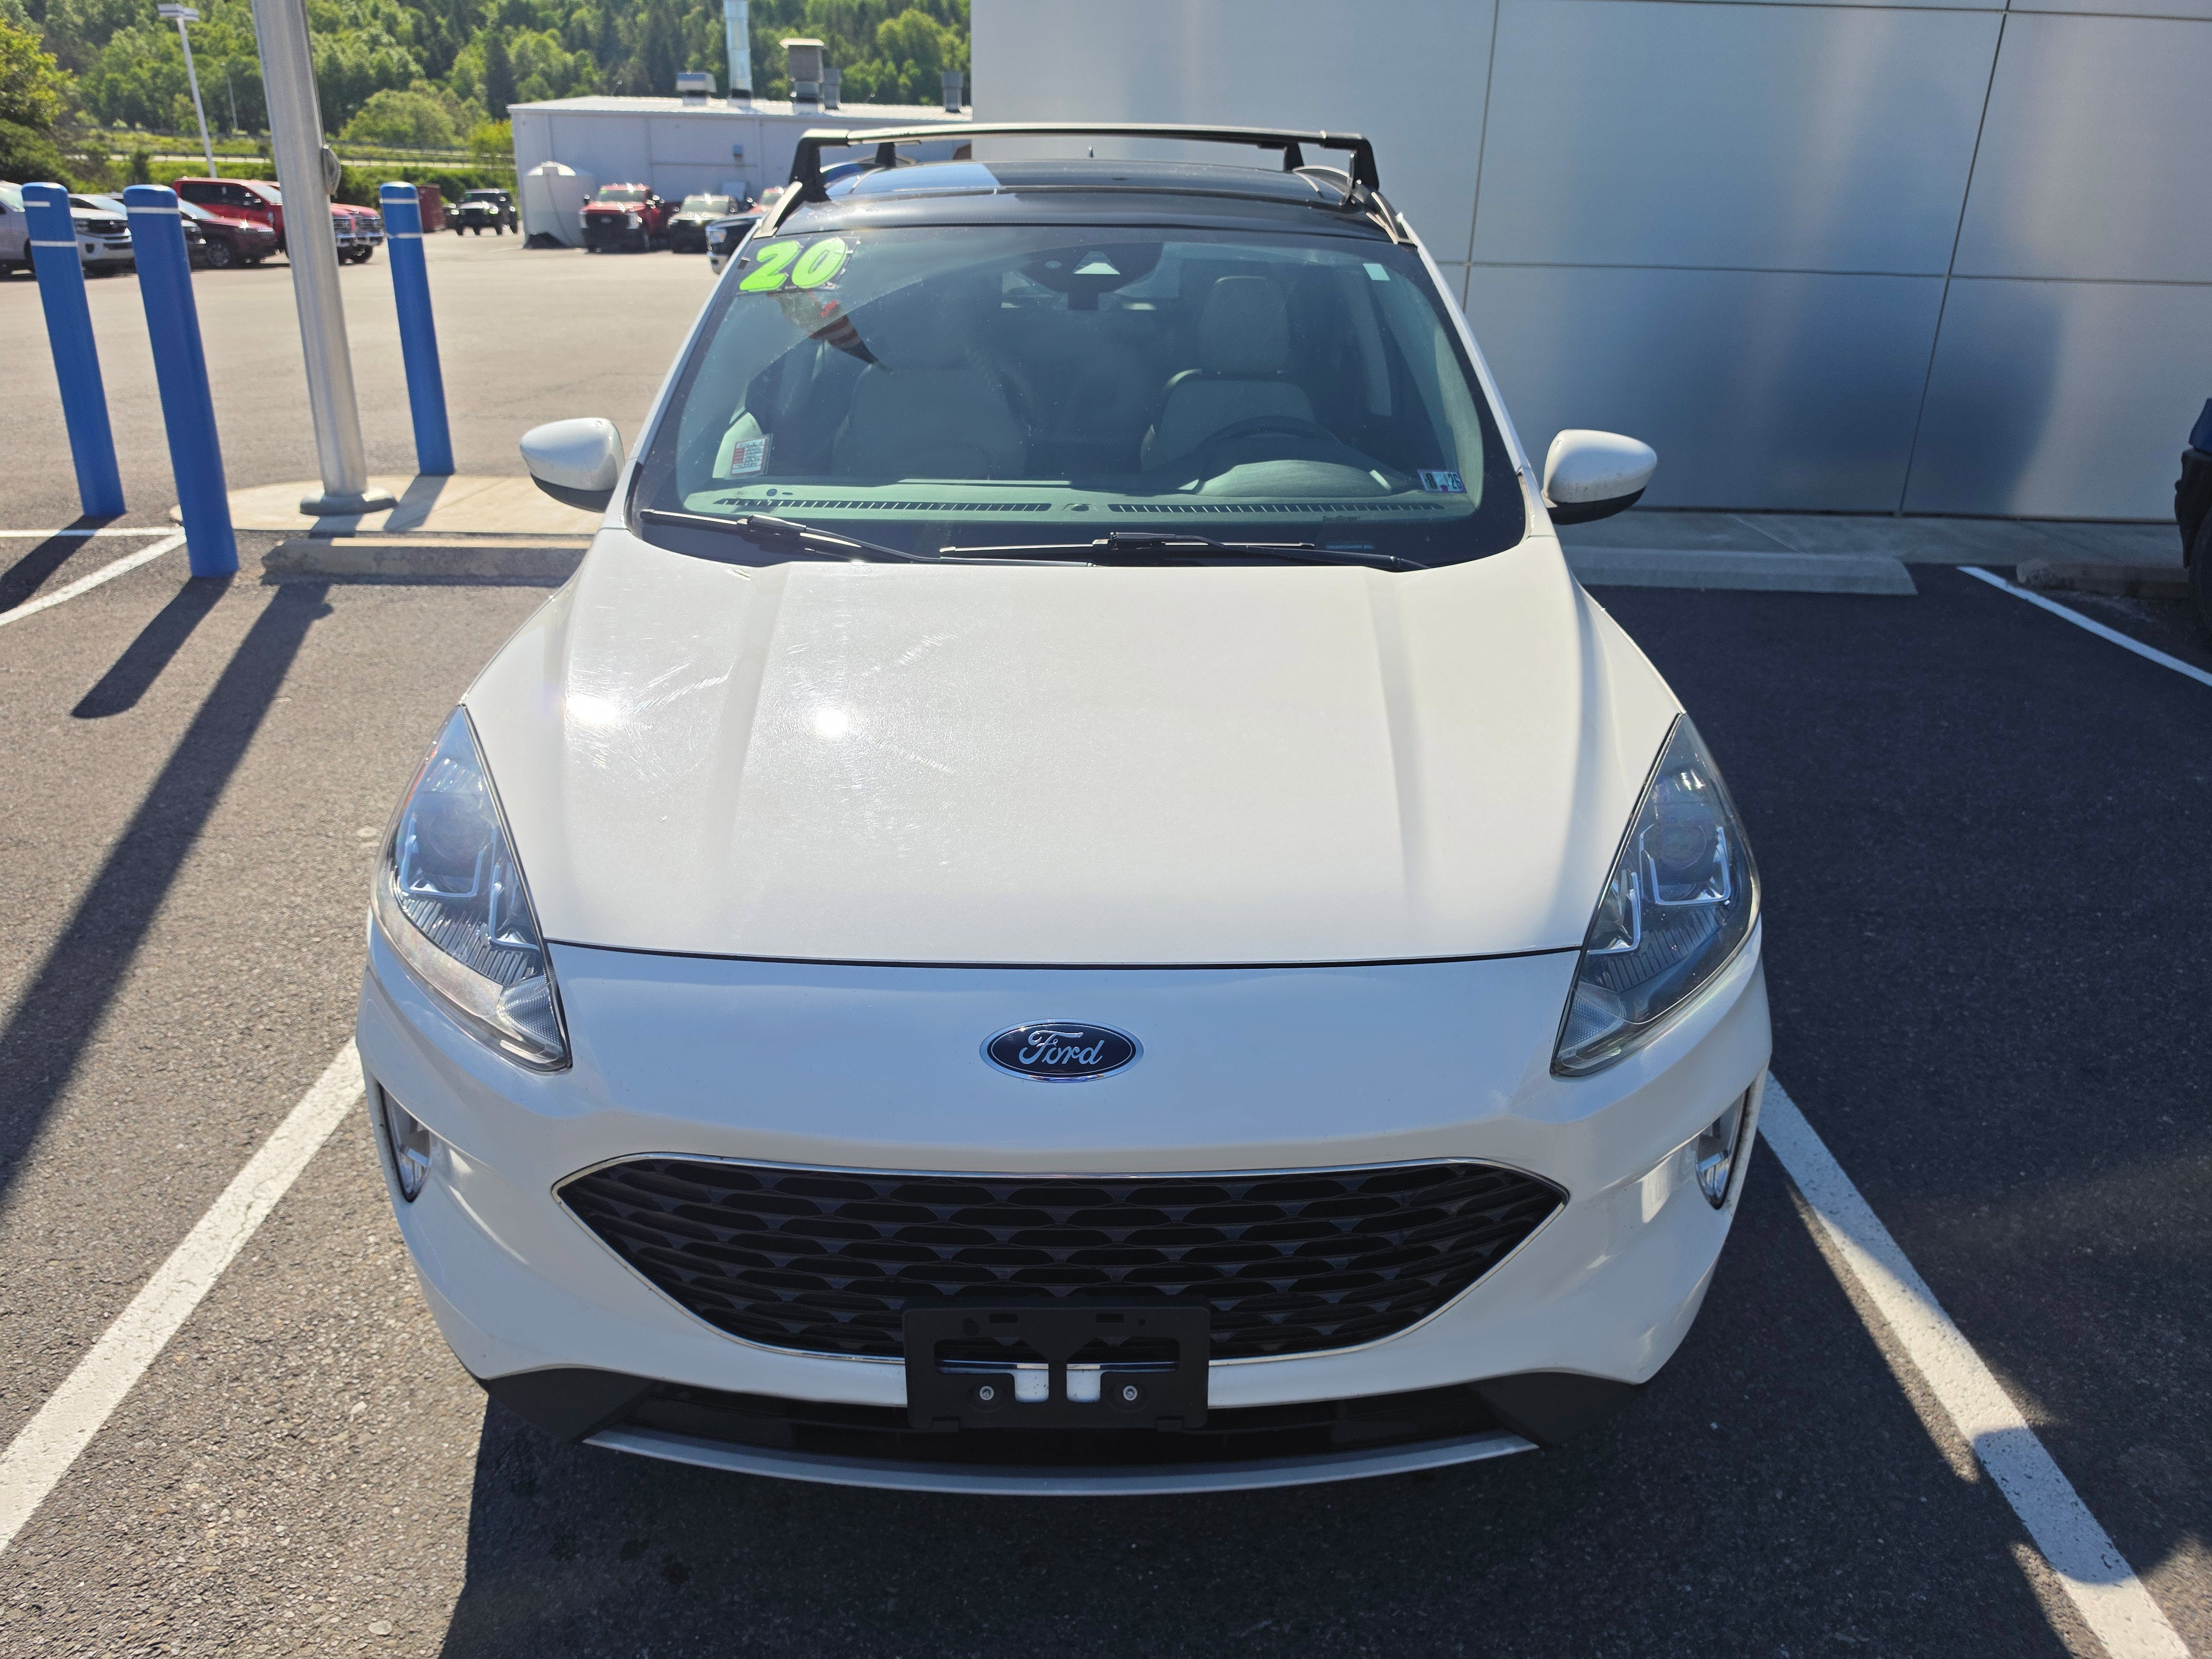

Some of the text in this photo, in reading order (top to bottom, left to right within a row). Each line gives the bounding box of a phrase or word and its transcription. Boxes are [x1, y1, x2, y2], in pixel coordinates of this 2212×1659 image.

[739, 237, 849, 293] 20
[1448, 473, 1462, 489] 26
[1019, 1030, 1105, 1065] Ford
